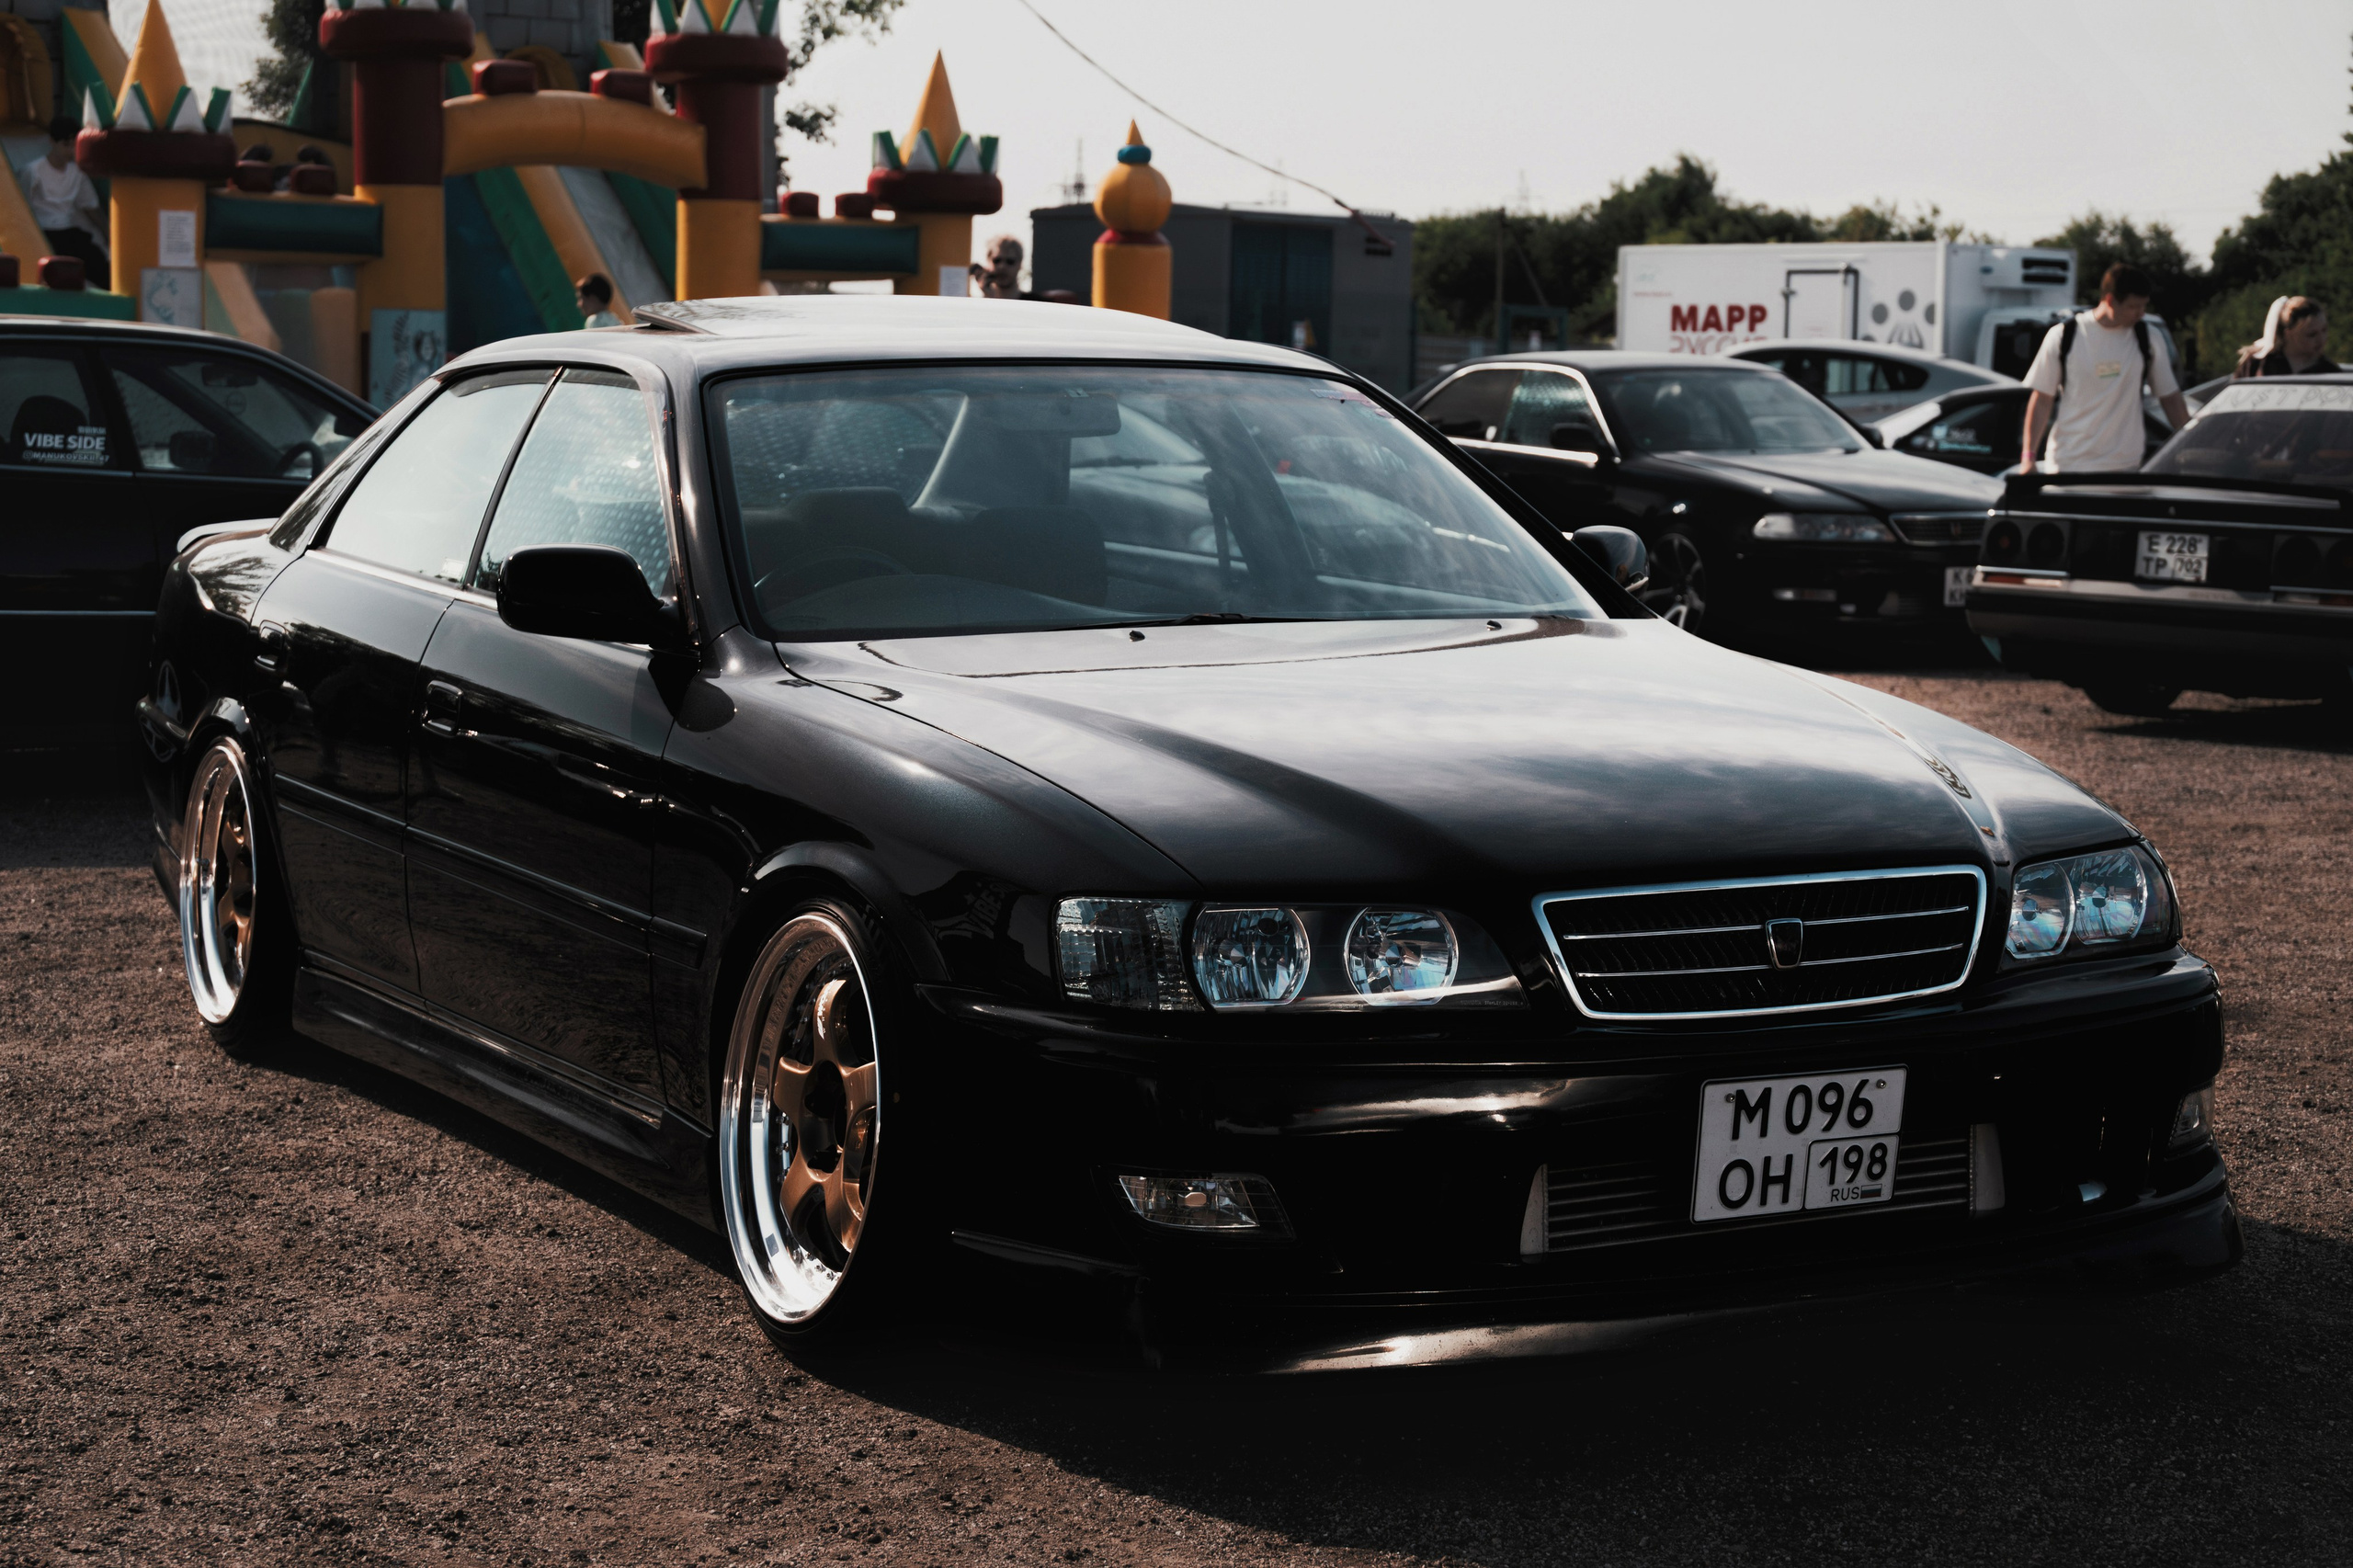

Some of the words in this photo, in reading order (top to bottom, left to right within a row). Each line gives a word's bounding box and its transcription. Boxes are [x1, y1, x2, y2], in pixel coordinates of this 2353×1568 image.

[1670, 303, 1768, 333] МАРР
[24, 432, 65, 449] VIBE
[66, 435, 107, 450] SIDE
[2146, 534, 2161, 553] E
[2143, 555, 2168, 575] TP
[1731, 1086, 1772, 1141] M
[1784, 1078, 1874, 1135] 096
[1718, 1153, 1793, 1210] OH
[1818, 1142, 1889, 1185] 198
[1830, 1187, 1860, 1202] RUS
